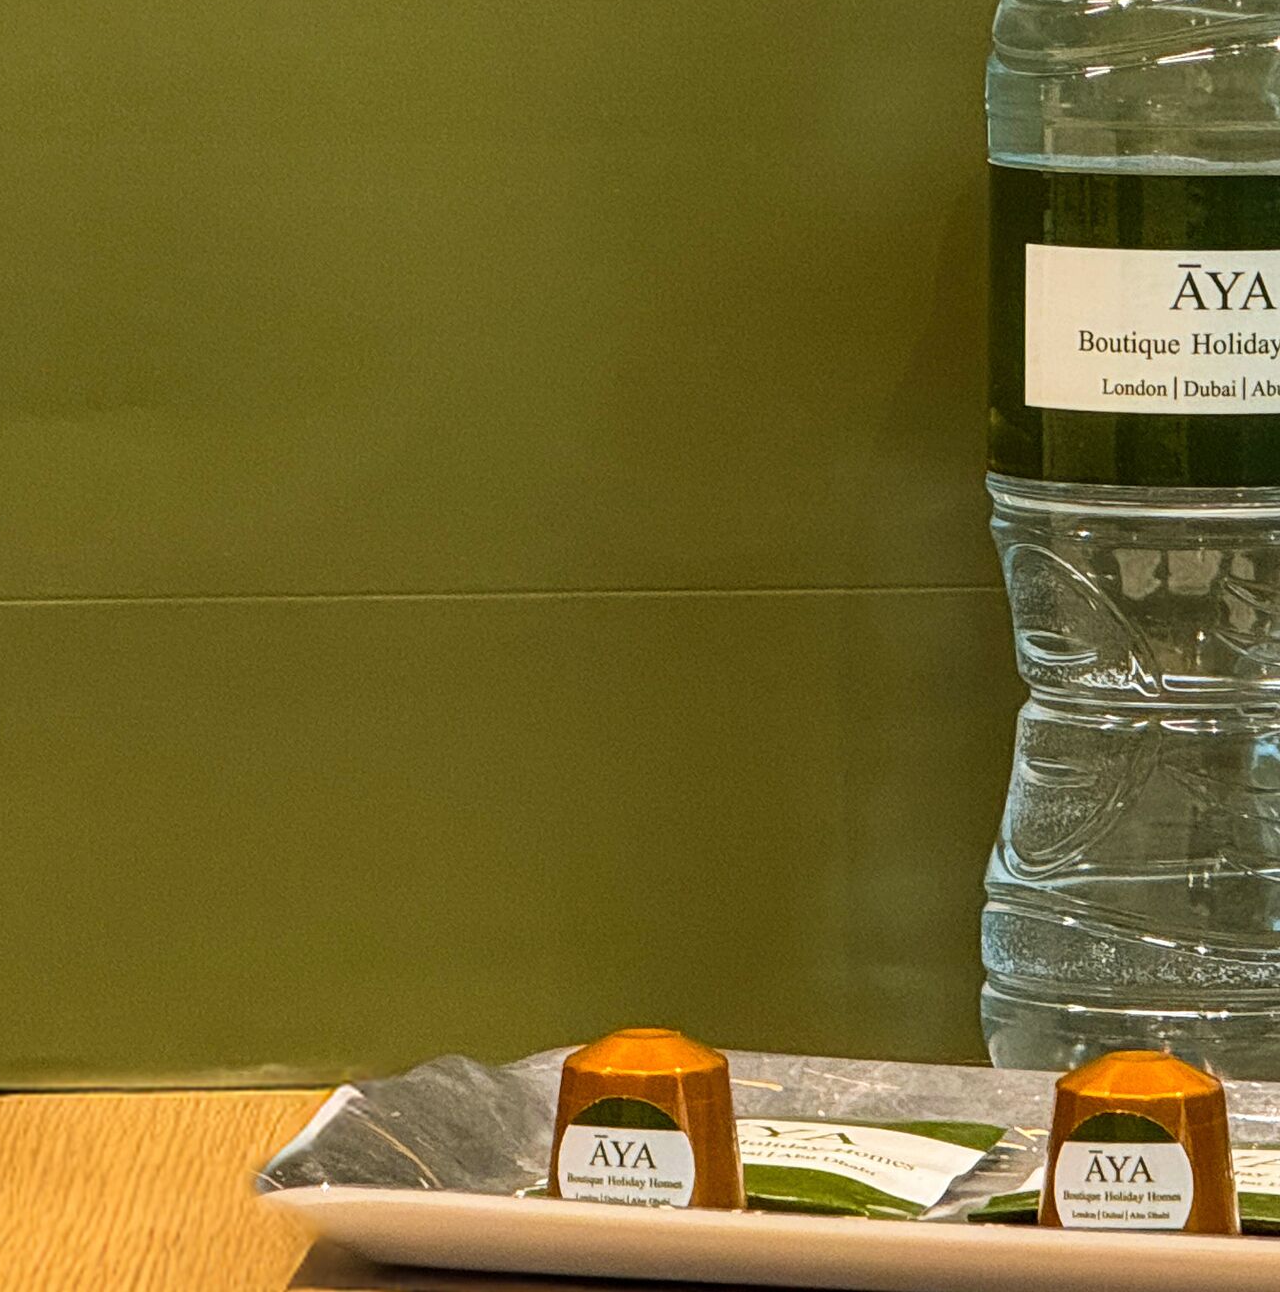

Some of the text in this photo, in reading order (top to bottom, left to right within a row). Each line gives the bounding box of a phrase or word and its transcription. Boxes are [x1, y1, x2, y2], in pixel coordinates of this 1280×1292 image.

[1169, 264, 1277, 310] ĀYA
[1078, 330, 1181, 360] Boutique
[1102, 378, 1167, 398] London
[1183, 380, 1236, 398] Dubai
[589, 1134, 657, 1169] ĀYA
[1085, 1149, 1155, 1183] ĀYA
[607, 1175, 646, 1190] Holiday
[649, 1178, 683, 1189] Homes
[1105, 1191, 1144, 1204] Holiday
[1147, 1192, 1182, 1202] Homes
